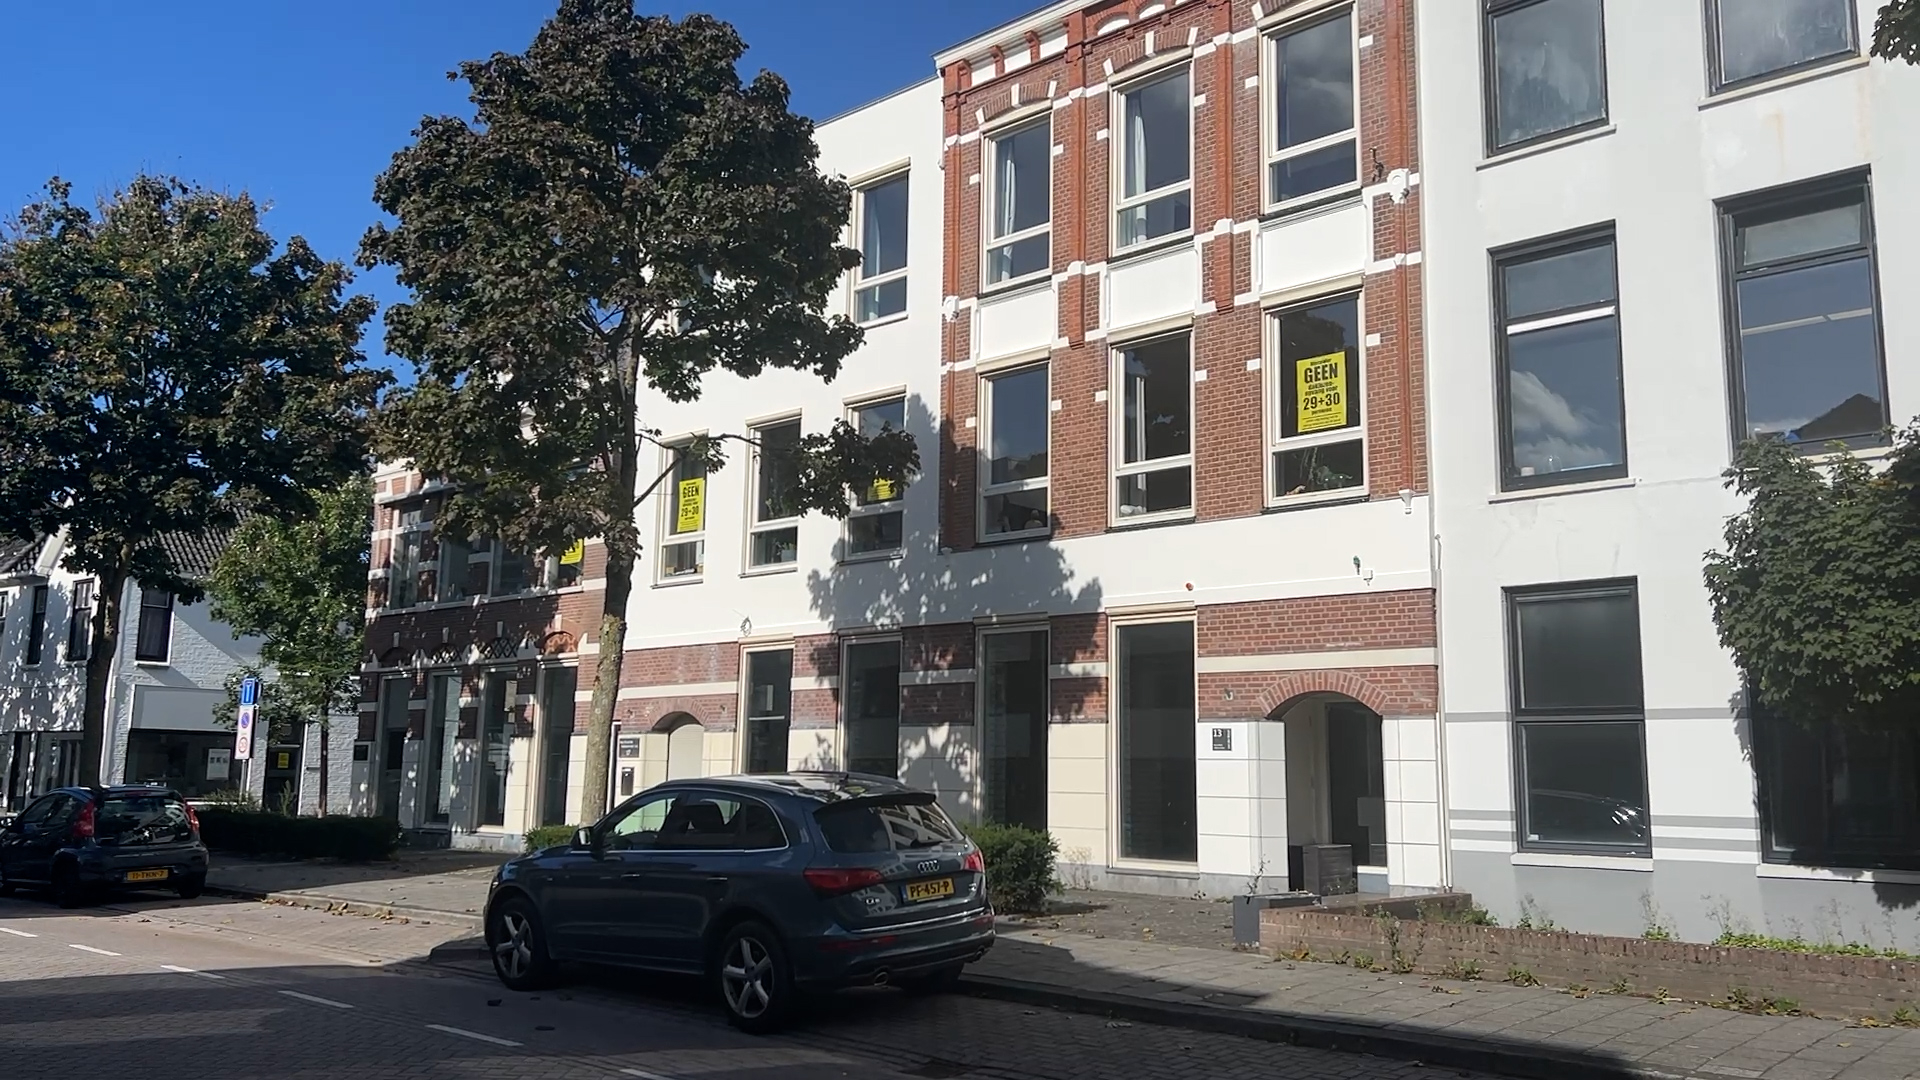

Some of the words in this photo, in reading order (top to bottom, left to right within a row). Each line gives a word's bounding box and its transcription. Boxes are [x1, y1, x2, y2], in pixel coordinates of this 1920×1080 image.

[1304, 362, 1338, 383] GEEN
[1303, 392, 1340, 410] 29+30
[683, 485, 700, 498] GEEN
[1213, 729, 1223, 738] 13
[909, 881, 950, 898] PF-457-P
